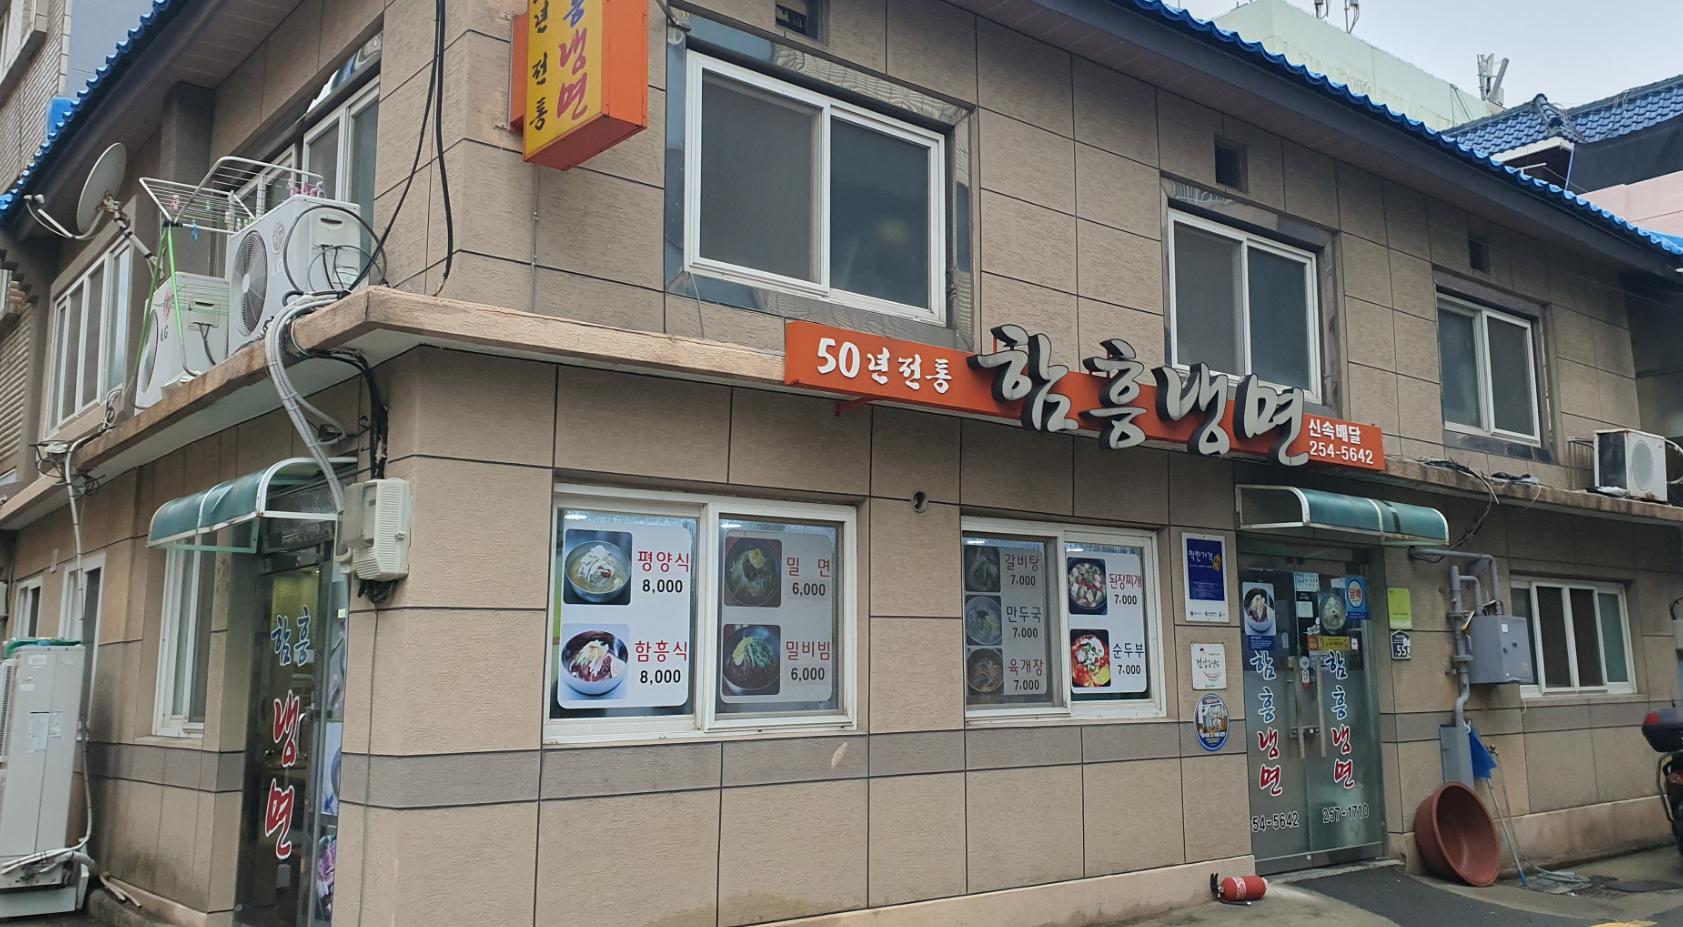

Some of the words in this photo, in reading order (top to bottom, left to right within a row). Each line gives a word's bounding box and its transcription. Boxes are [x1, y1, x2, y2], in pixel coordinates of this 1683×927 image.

[530, 0, 549, 131] 년전통
[160, 324, 168, 342] LG
[817, 337, 952, 394] 50년전통
[966, 324, 1309, 467] 함흥냉면
[1308, 419, 1361, 445] 신속배달
[1309, 440, 1374, 465] 254-5642
[637, 550, 690, 573] 평양식
[1004, 553, 1040, 573] 갈비탕
[642, 579, 683, 594] 8,000
[792, 582, 826, 597] 6,000
[1109, 573, 1143, 590] 된장찌개
[1006, 605, 1042, 623] 만두국
[1012, 627, 1039, 639] 7,000
[635, 640, 687, 663] 함흥식
[786, 640, 830, 662] 밀비빔
[1112, 642, 1145, 659] 순두부
[640, 669, 681, 684] 8,000
[790, 667, 825, 682] 6,000
[1008, 658, 1044, 677] 육개장
[1117, 664, 1141, 675] 7,000
[1013, 679, 1040, 691] 7,000
[1250, 650, 1283, 797] 함흥냉면
[1325, 650, 1355, 789] 함흥냉면
[1322, 803, 1369, 823] 257-1710
